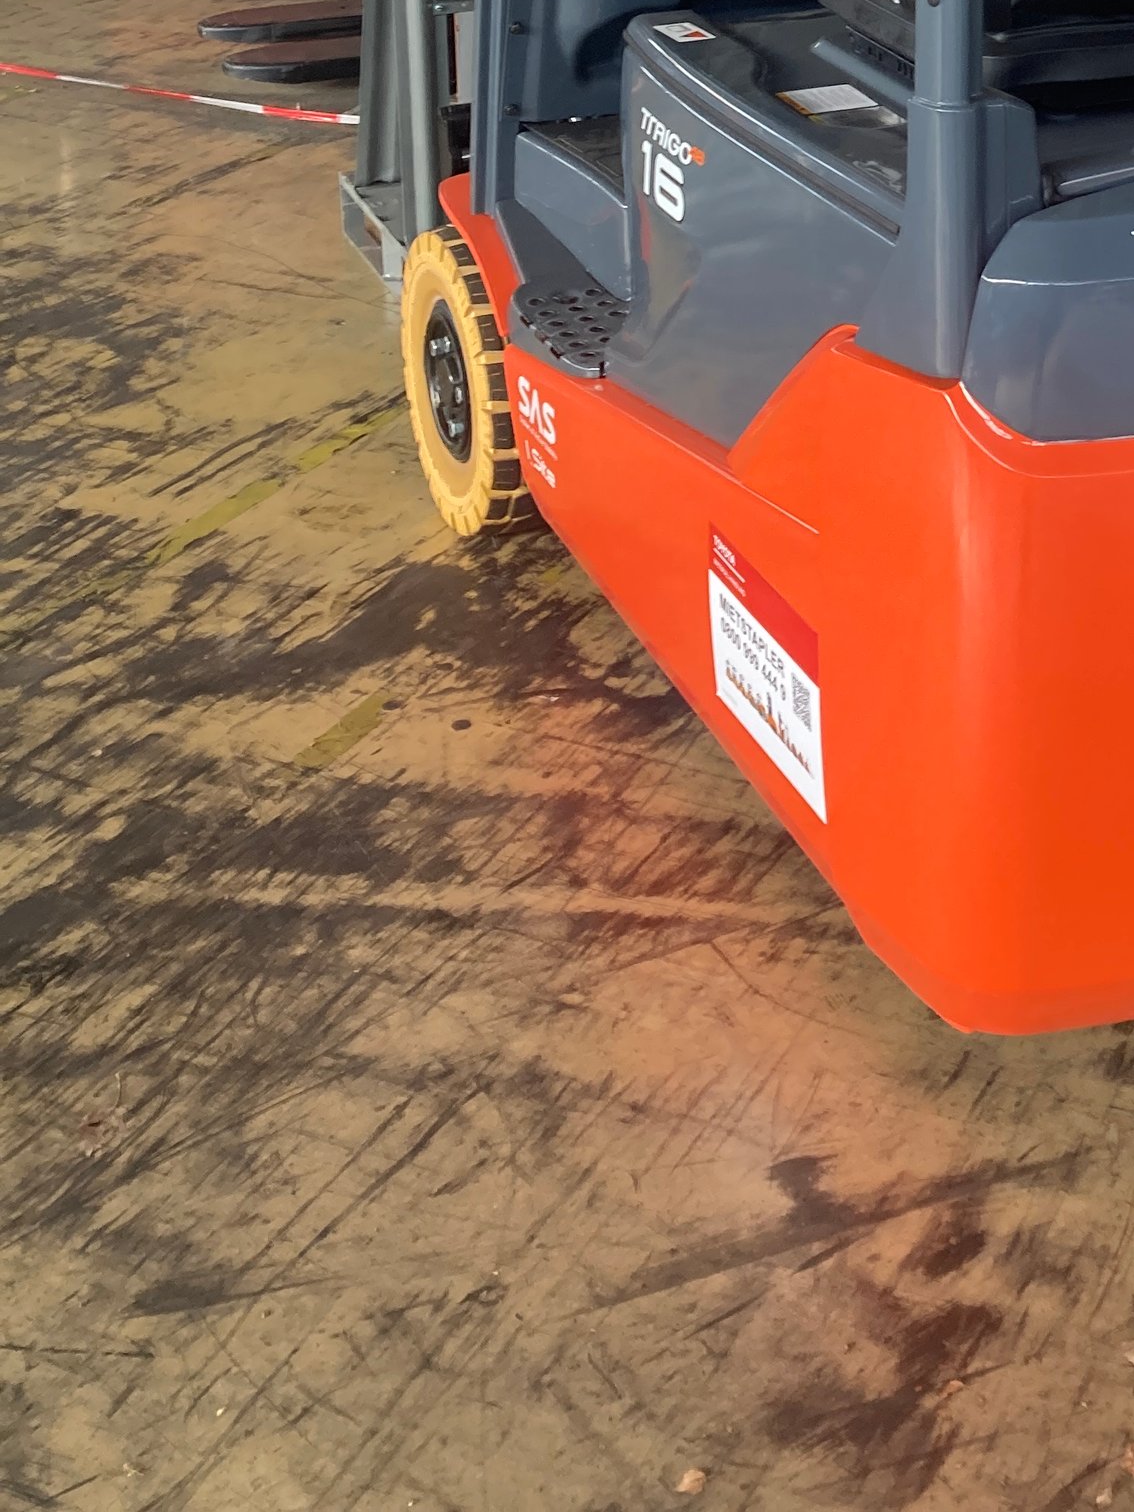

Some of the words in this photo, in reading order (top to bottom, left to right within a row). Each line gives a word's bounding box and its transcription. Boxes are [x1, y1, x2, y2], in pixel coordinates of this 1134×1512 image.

[641, 139, 685, 222] 16
[517, 375, 557, 445] SAS
[719, 592, 785, 679] MIETSTAPLER
